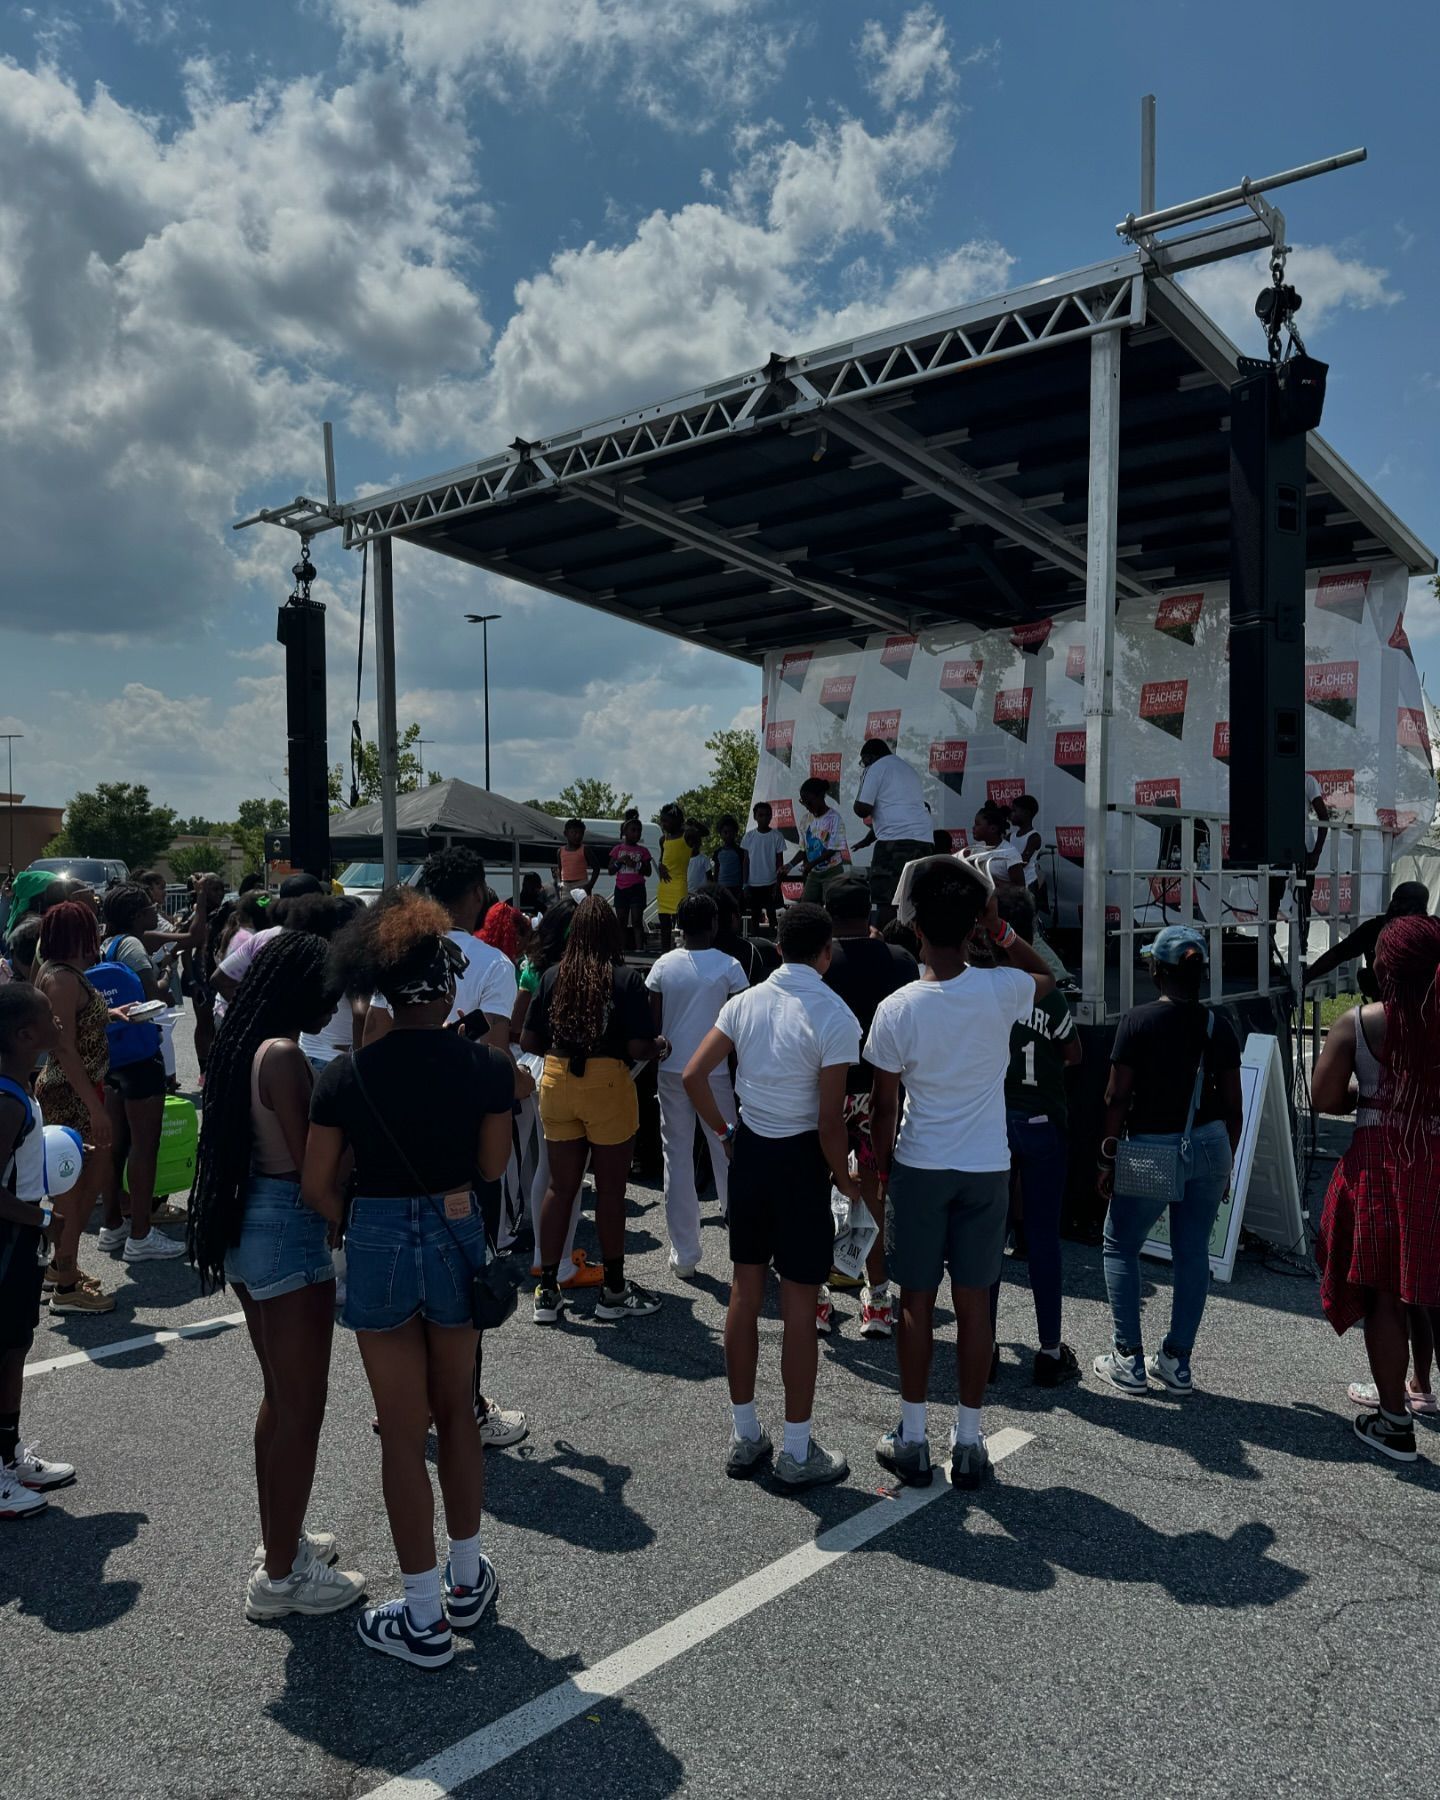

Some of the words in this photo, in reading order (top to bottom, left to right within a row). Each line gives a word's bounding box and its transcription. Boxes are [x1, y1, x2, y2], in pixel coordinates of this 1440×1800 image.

[1322, 577, 1364, 595] TEACHER
[945, 668, 979, 679] TEACHER
[1309, 672, 1354, 687] TEACHER
[824, 683, 852, 694] TEACHER
[997, 696, 1028, 710] TEACHER
[1145, 690, 1183, 704] TEACHER
[869, 719, 898, 731] TEACHER
[769, 728, 792, 739] TEACHER
[1060, 741, 1085, 753] TEACH
[933, 750, 963, 761] TEACHER
[812, 761, 841, 773] TEACHER
[1060, 836, 1084, 847] TEACH
[1312, 887, 1352, 901] EACER
[1021, 1040, 1038, 1087] 1
[846, 1243, 863, 1260] DAY
